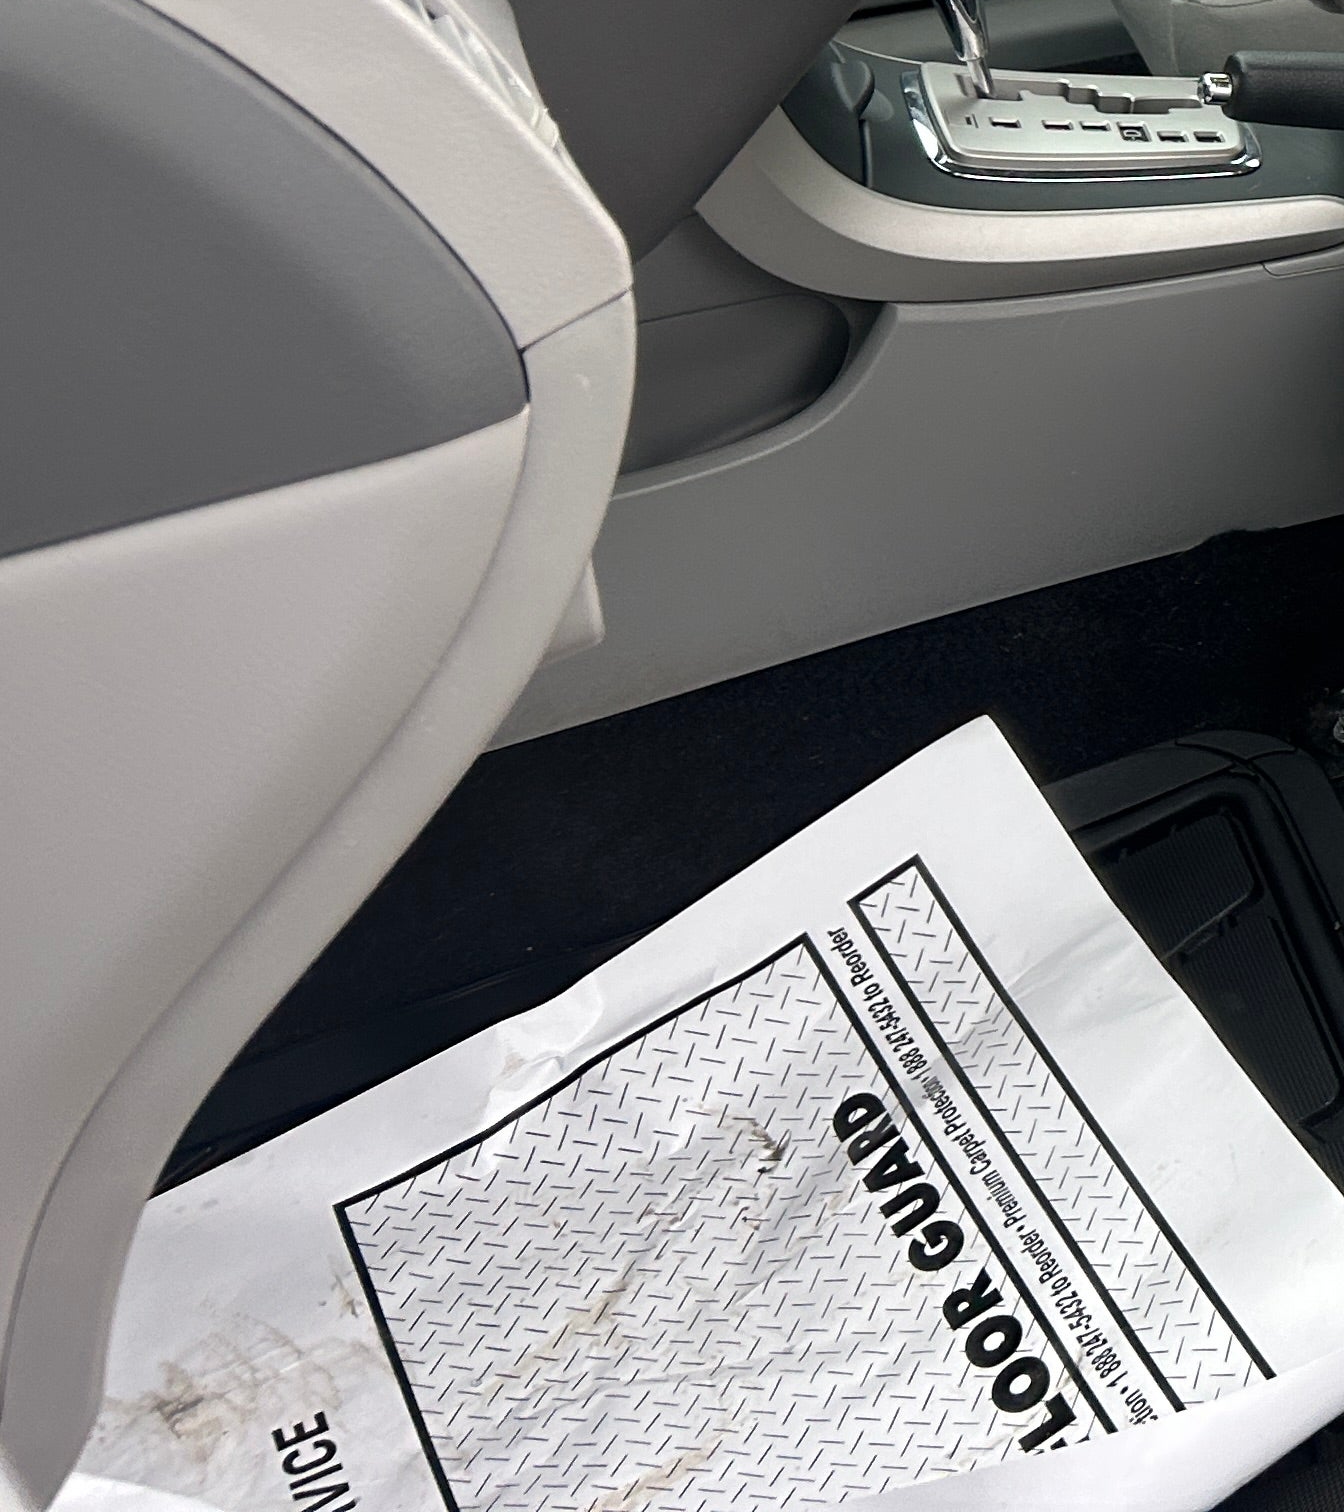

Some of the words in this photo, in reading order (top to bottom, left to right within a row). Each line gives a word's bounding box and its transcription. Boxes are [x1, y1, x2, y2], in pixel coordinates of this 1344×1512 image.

[827, 927, 873, 987] Reorder
[864, 983, 884, 1001] to
[868, 997, 914, 1052] 247-5432
[899, 1047, 927, 1074] 888
[952, 1128, 991, 1175] Carpet
[833, 1092, 965, 1272] GUARD
[982, 1170, 1027, 1228] Premium
[1020, 1229, 1062, 1284] Reorder
[1050, 1276, 1071, 1297] to
[1056, 1291, 1108, 1356] 247-5432
[942, 1267, 1090, 1454] LOOR
[1092, 1348, 1121, 1378] 888
[1125, 1389, 1158, 1425] tion
[270, 1410, 362, 1512] VICE
